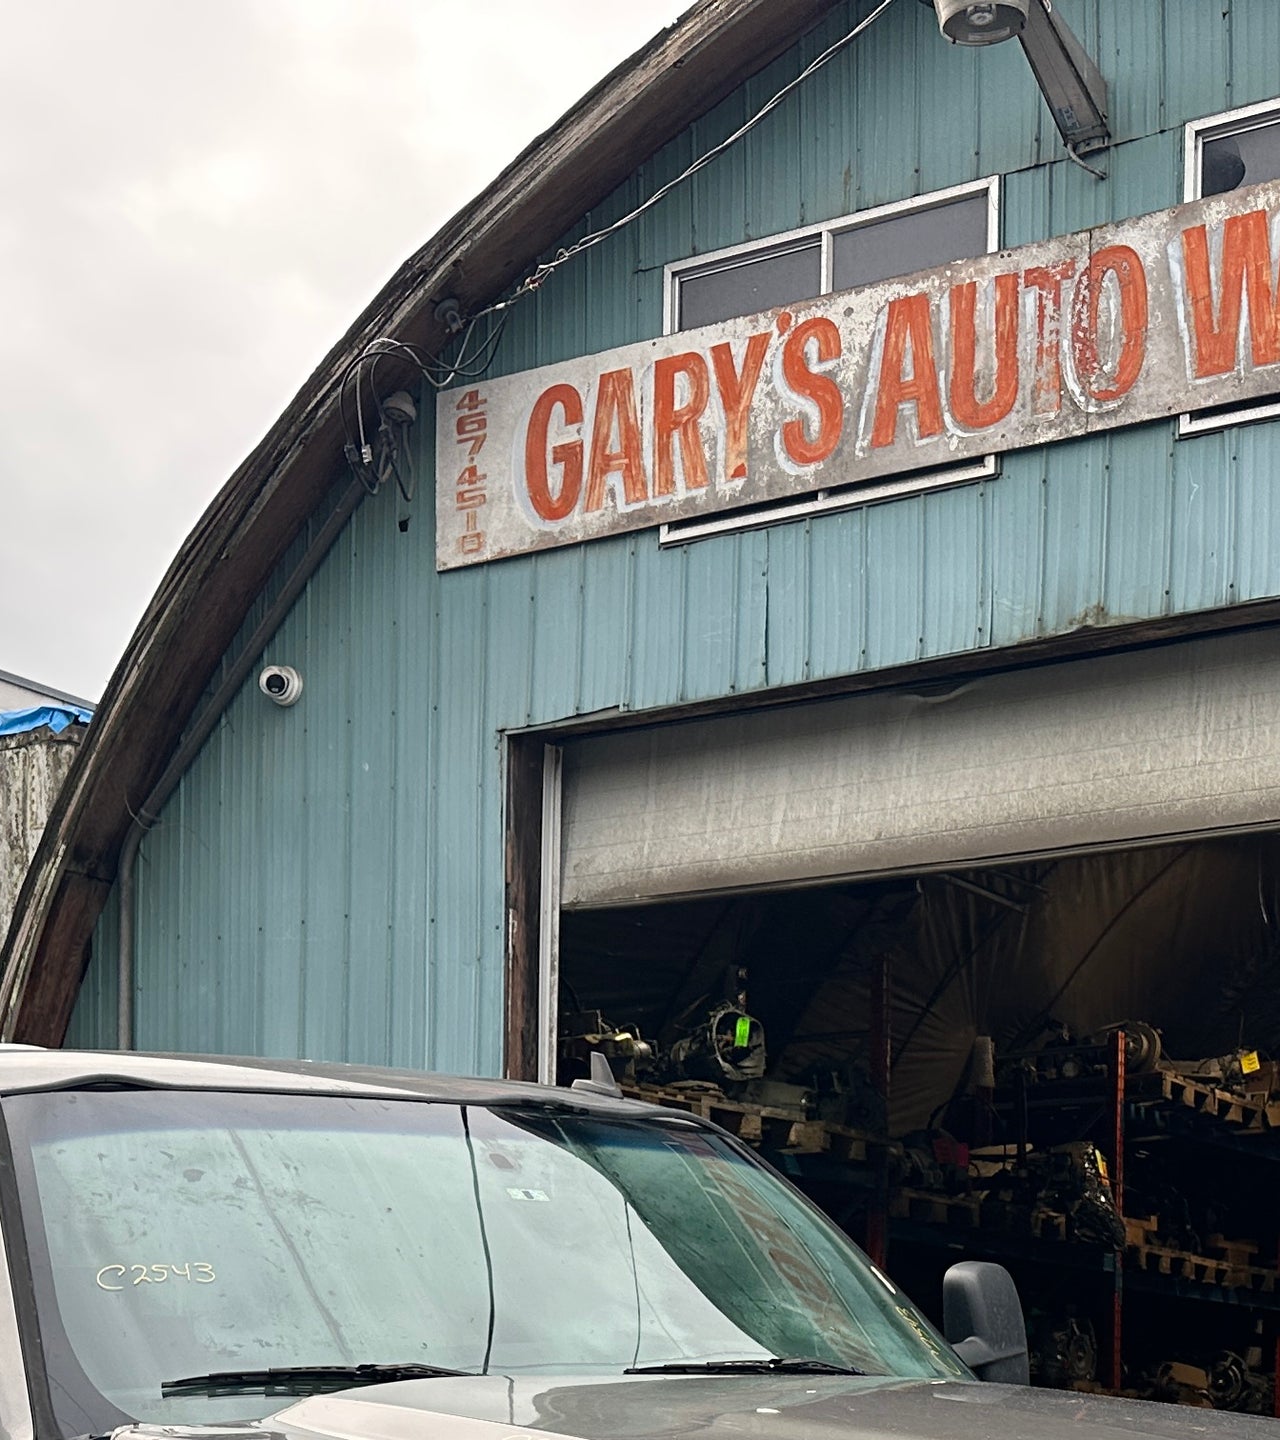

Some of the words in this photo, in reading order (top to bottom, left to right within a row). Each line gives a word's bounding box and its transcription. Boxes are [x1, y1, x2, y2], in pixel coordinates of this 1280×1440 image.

[524, 311, 843, 522] GARY'S
[870, 244, 1149, 449] AUTO
[96, 1262, 216, 1291] C2543
